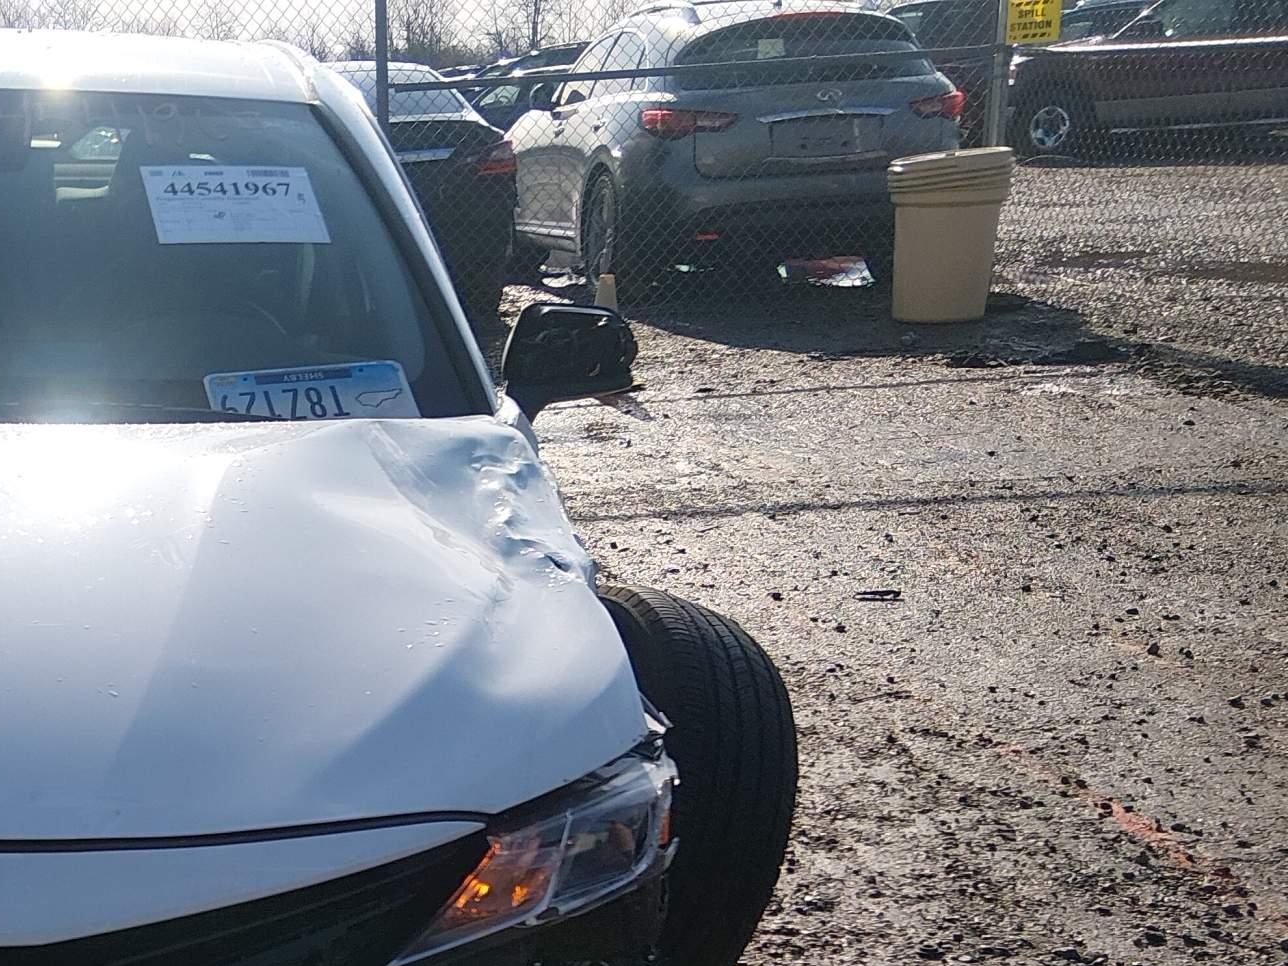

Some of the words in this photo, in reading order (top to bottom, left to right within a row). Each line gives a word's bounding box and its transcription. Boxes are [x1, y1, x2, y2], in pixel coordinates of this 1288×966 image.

[1018, 8, 1046, 18] SPILL
[1010, 20, 1052, 32] STATION
[164, 182, 290, 197] 44541967
[283, 371, 325, 382] SHELBY
